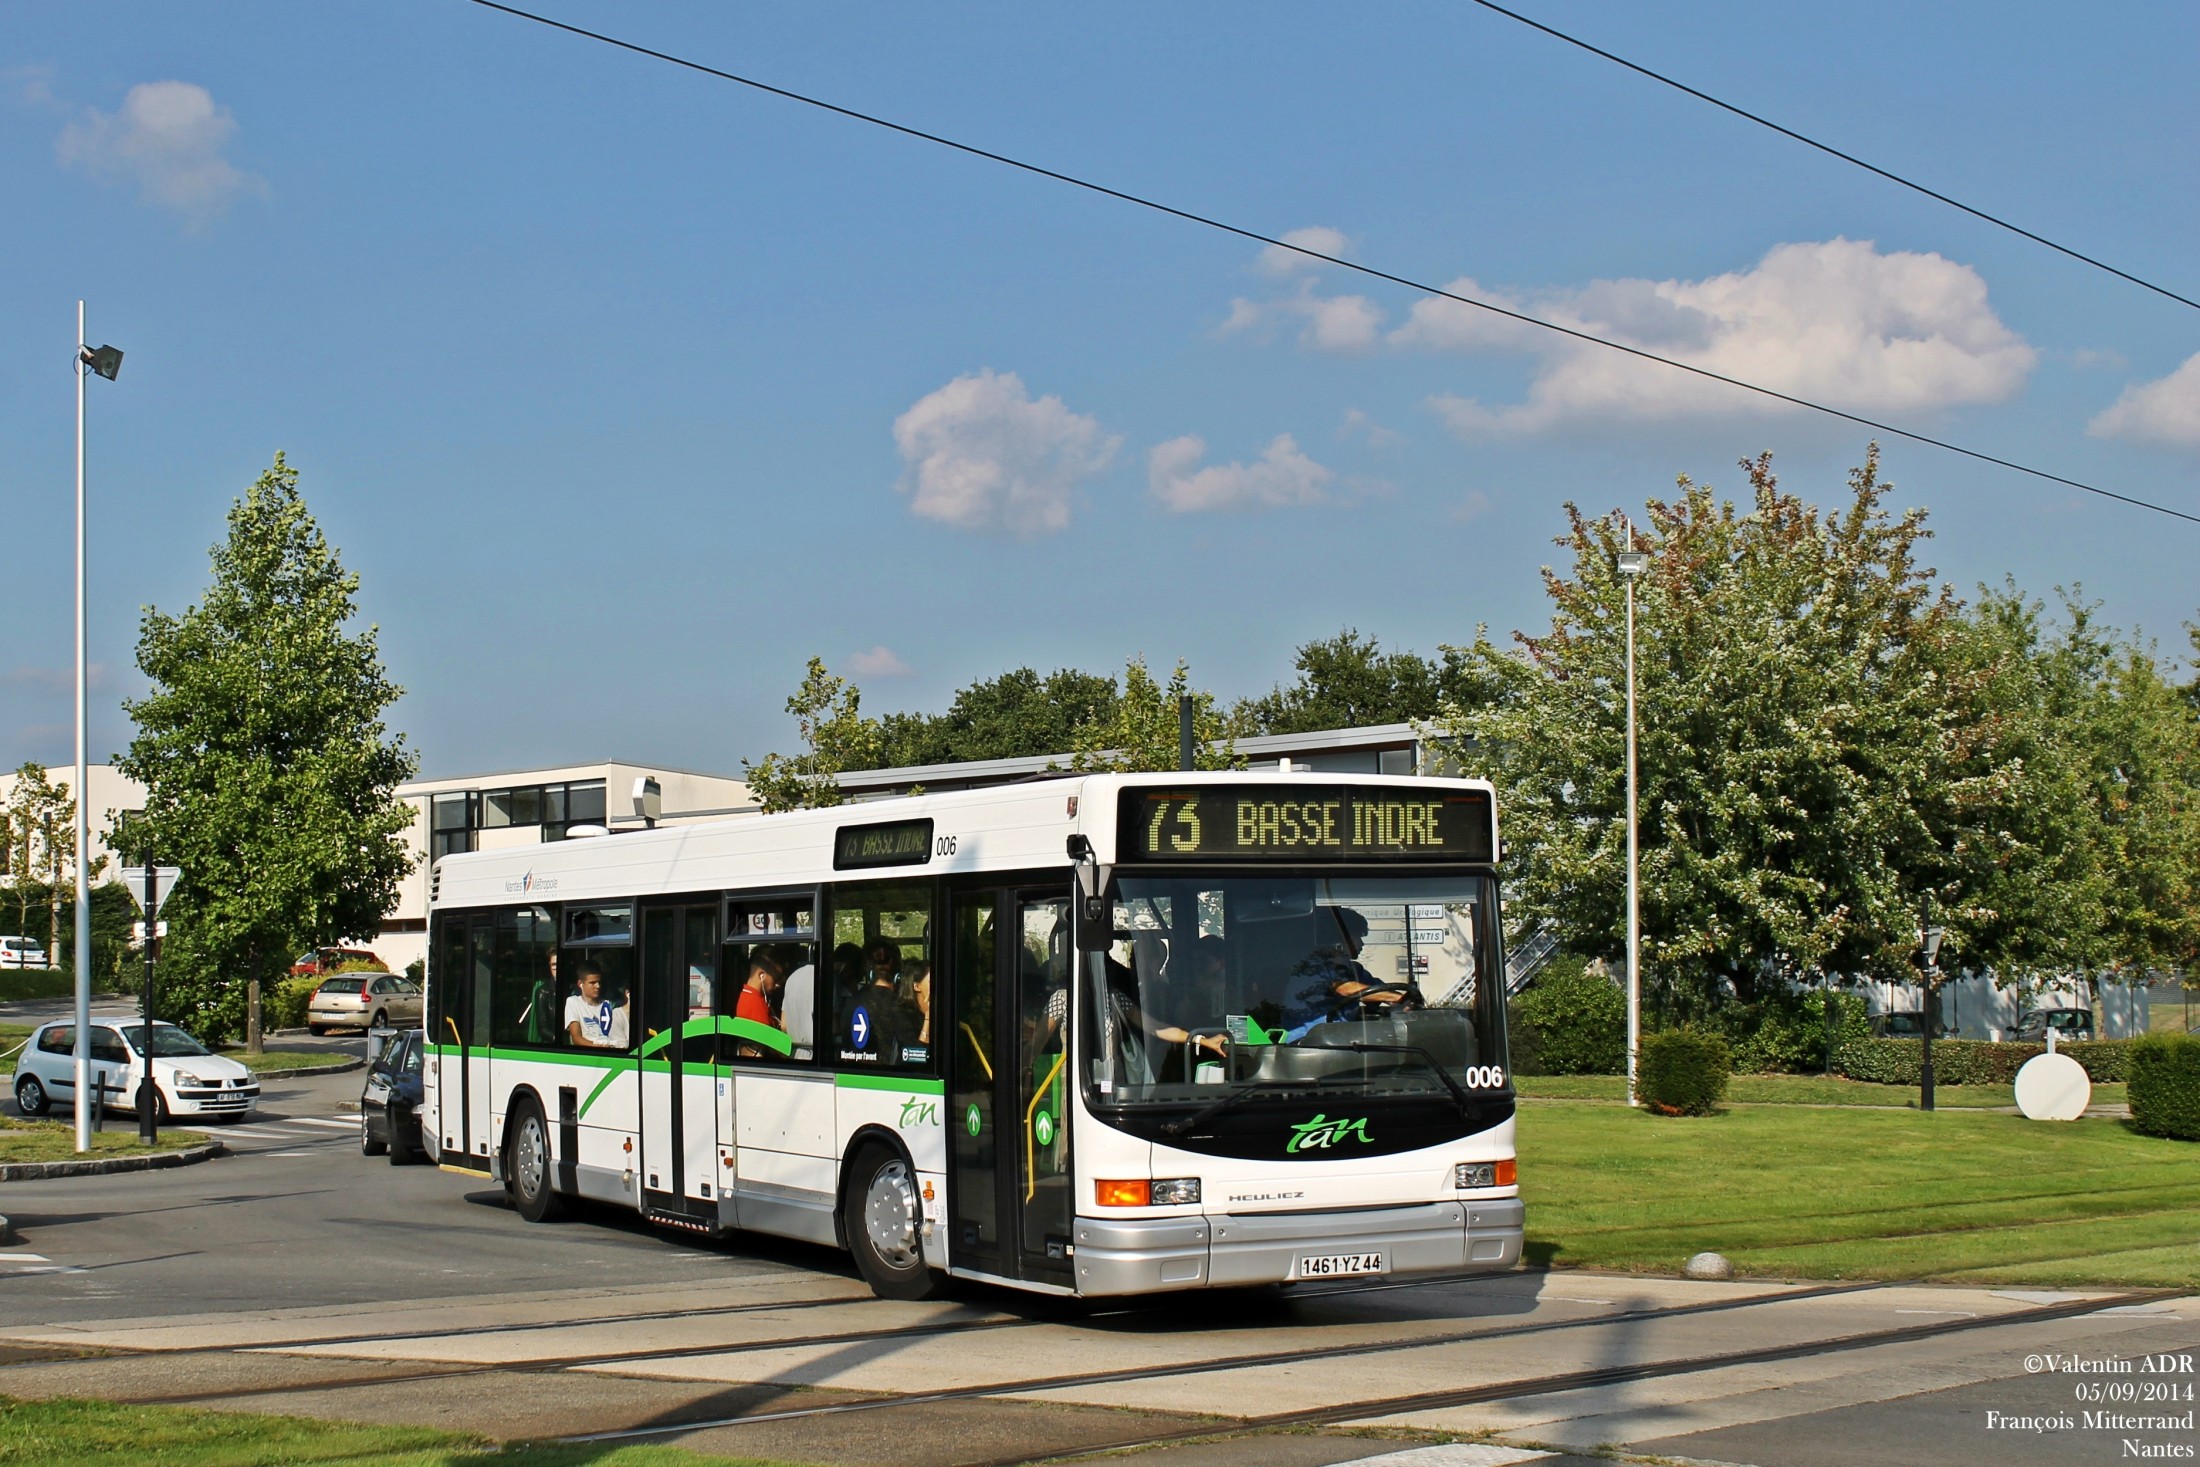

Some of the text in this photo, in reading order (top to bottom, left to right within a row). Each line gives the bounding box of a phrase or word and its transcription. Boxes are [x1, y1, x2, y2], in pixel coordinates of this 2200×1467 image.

[1147, 796, 1444, 852] 73 BASSE INDRE
[936, 835, 957, 856] 006
[1393, 907, 1440, 918] Urlogique
[1397, 932, 1441, 941] ATANTIS
[1465, 1065, 1504, 1089] 006
[899, 1095, 940, 1129] tan
[1286, 1113, 1375, 1154] tan
[1228, 1191, 1305, 1202] HEULIEZ
[1303, 1254, 1381, 1274] 1461 YZ 44
